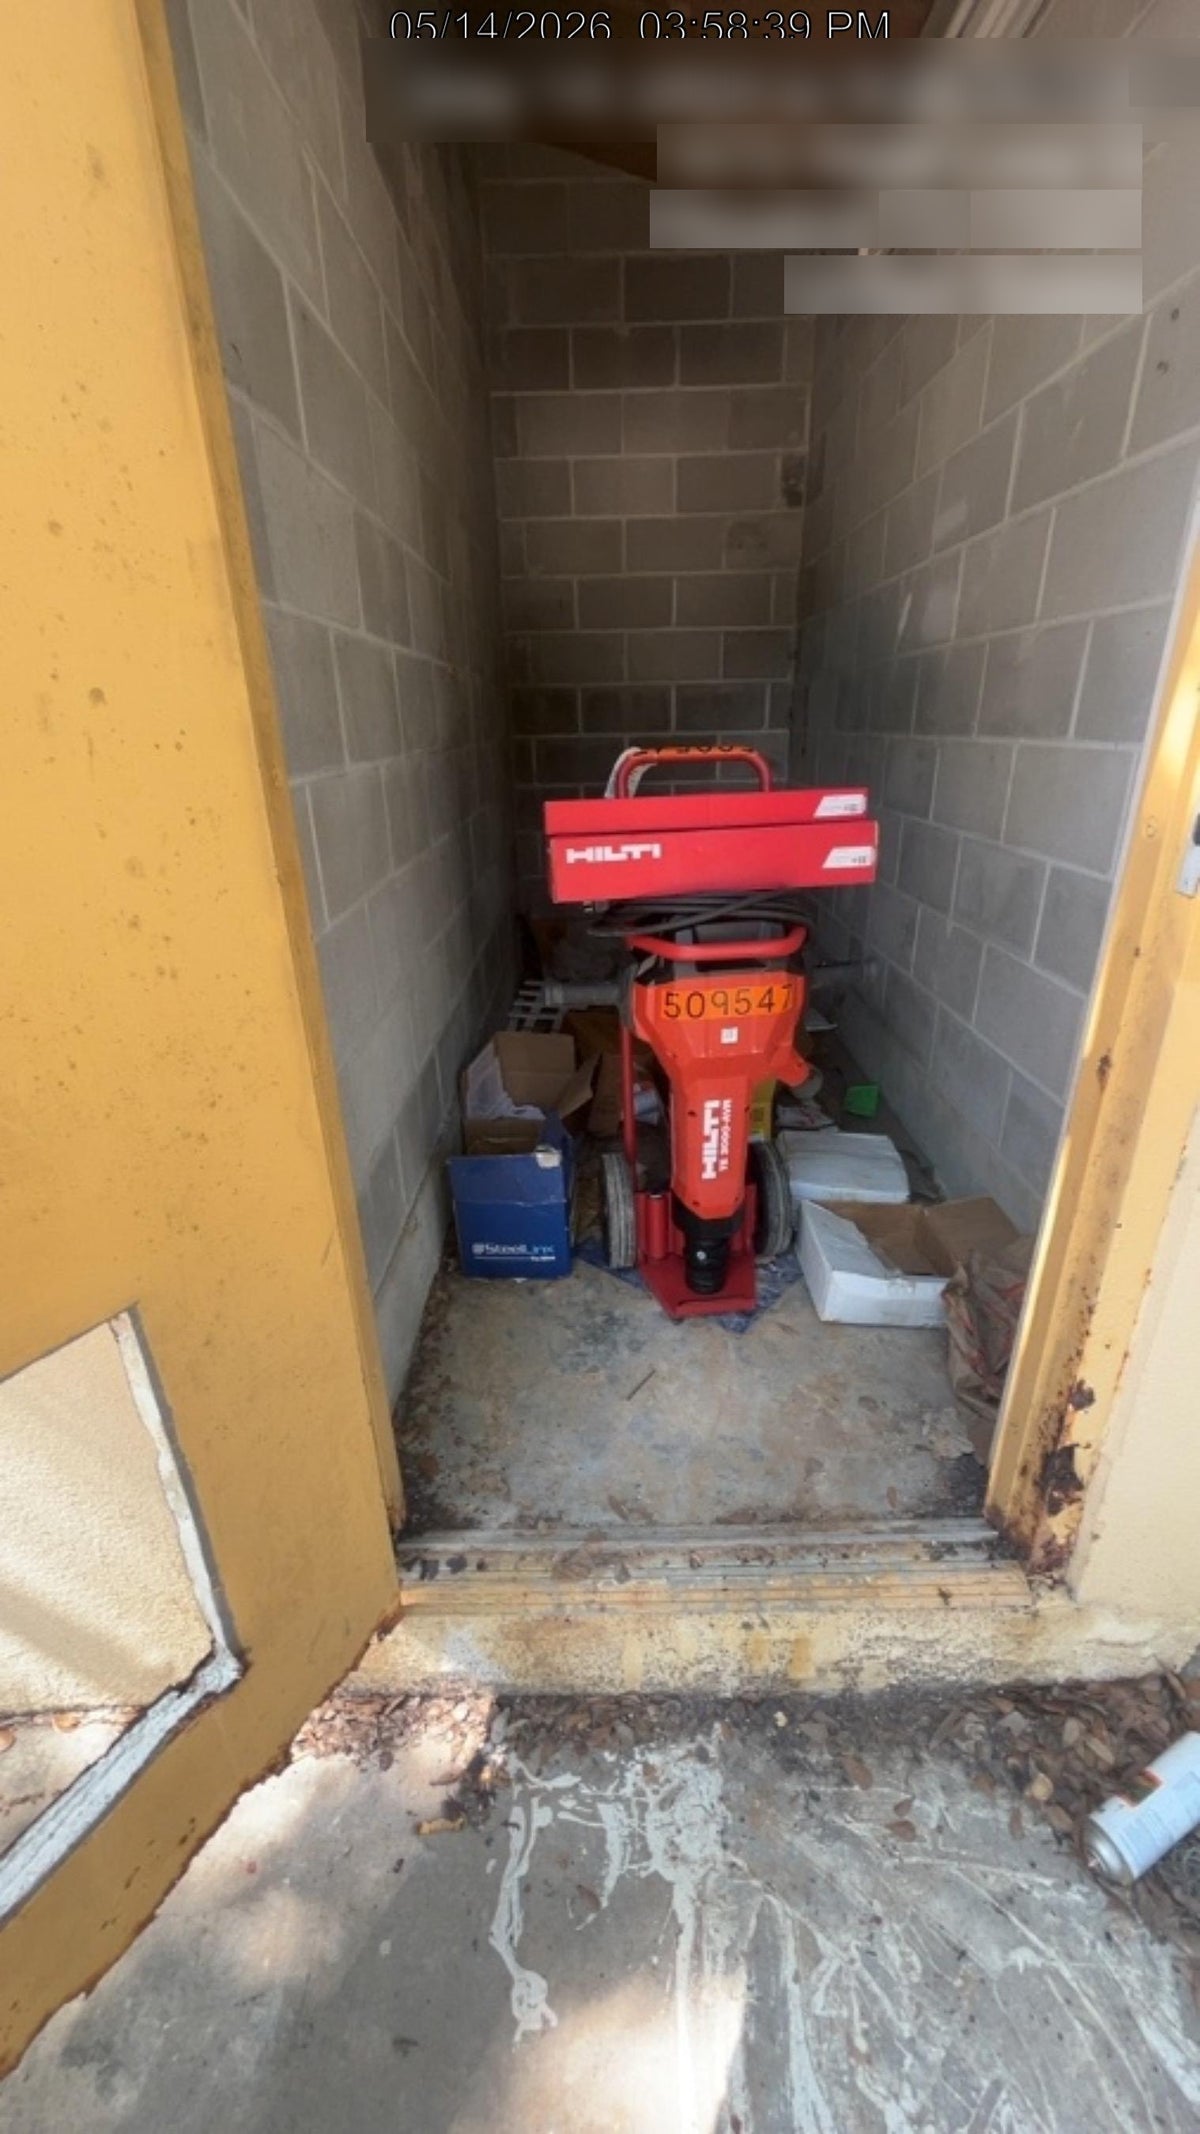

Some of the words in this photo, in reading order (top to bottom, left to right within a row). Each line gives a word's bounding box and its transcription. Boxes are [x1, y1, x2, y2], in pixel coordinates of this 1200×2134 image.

[566, 843, 661, 864] HILTI
[663, 984, 792, 1018] 509547
[702, 1099, 720, 1179] HILTI
